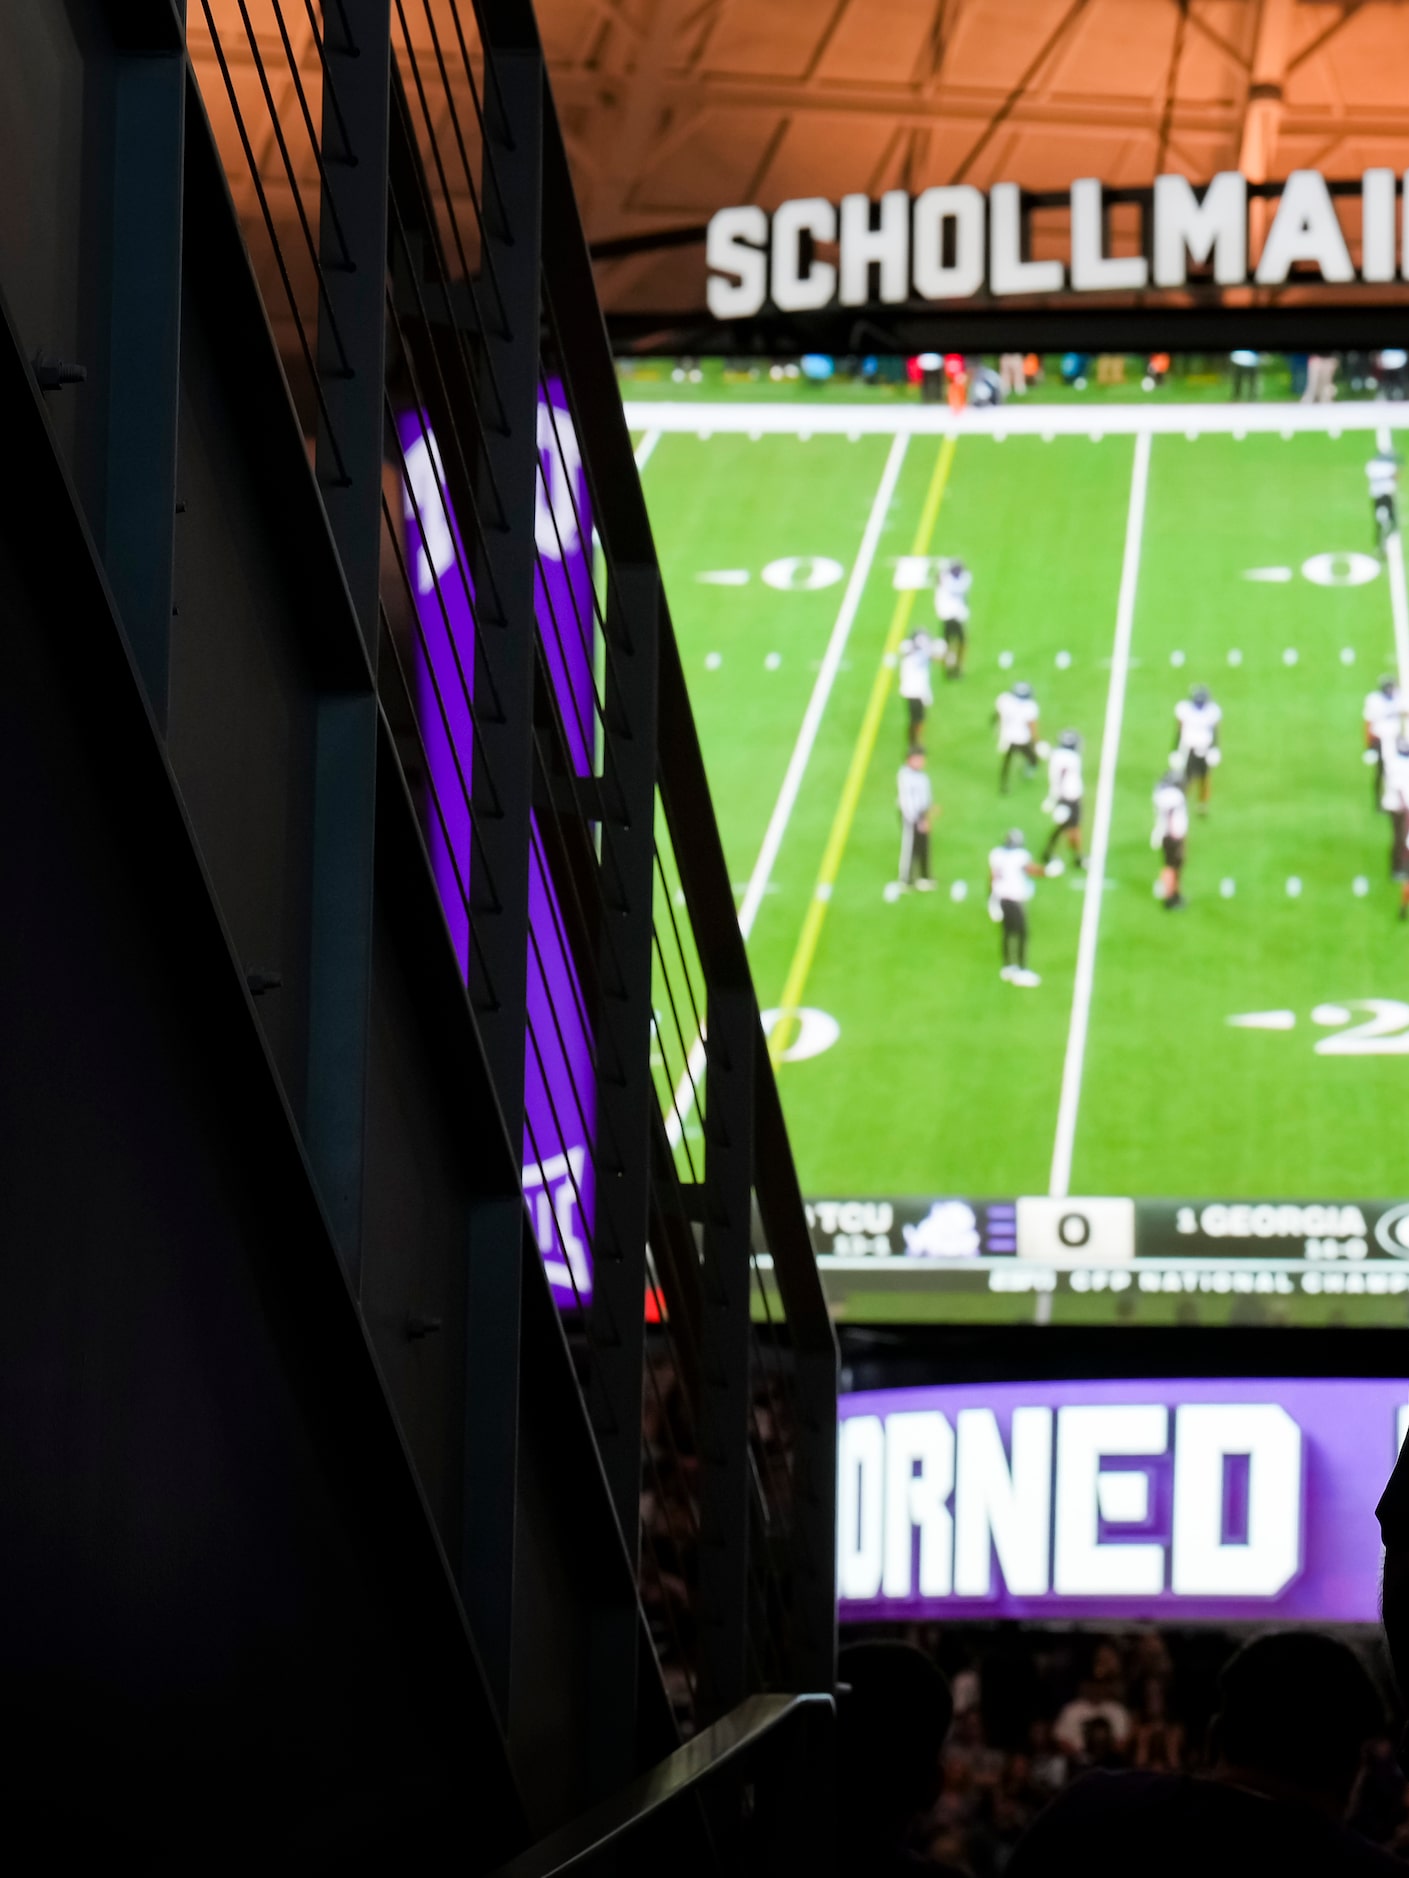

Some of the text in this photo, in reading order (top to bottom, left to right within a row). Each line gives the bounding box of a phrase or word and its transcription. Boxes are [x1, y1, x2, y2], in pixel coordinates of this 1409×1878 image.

[814, 1202, 893, 1234] TCU
[1058, 1213, 1091, 1247] 0
[1201, 1204, 1367, 1237] GEORGIA
[1139, 1270, 1294, 1293] NATIONAL
[838, 1402, 1302, 1600] ORNED
